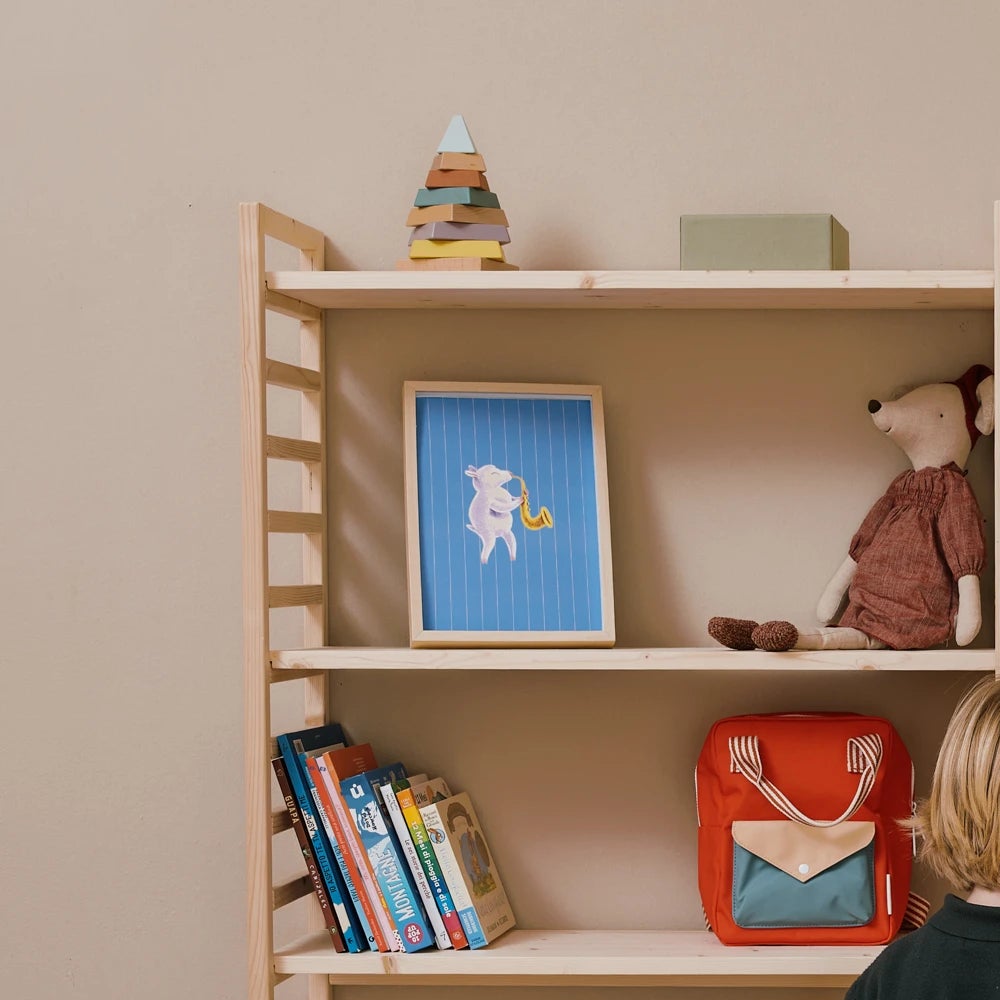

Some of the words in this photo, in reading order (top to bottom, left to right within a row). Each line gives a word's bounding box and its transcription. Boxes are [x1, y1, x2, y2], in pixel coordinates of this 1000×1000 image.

[283, 795, 300, 823] GUAPA
[302, 804, 316, 832] ASPETTI
[410, 820, 418, 830] 12
[415, 831, 426, 850] Mesi
[421, 849, 431, 859] di
[319, 854, 333, 885] ASPETTO
[424, 859, 442, 888] pioggia
[376, 849, 415, 922] MONTAGNE
[419, 880, 431, 899] perché
[438, 893, 447, 902] di
[442, 902, 452, 918] sole
